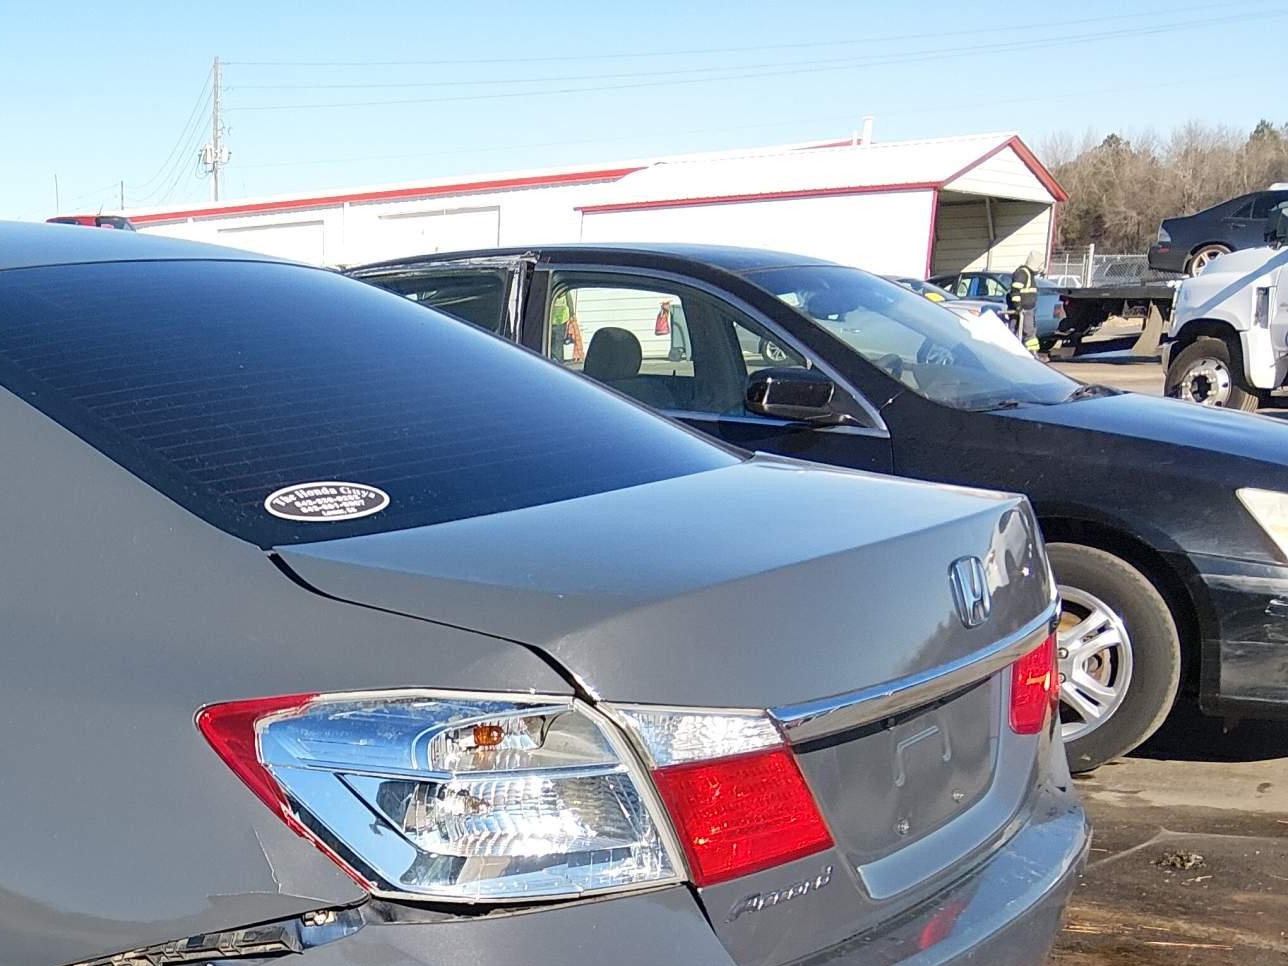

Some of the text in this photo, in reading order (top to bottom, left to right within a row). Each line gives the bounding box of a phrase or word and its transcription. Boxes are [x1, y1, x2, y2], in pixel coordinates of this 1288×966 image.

[272, 487, 376, 506] The Honda Guys
[724, 865, 833, 924] Accord
